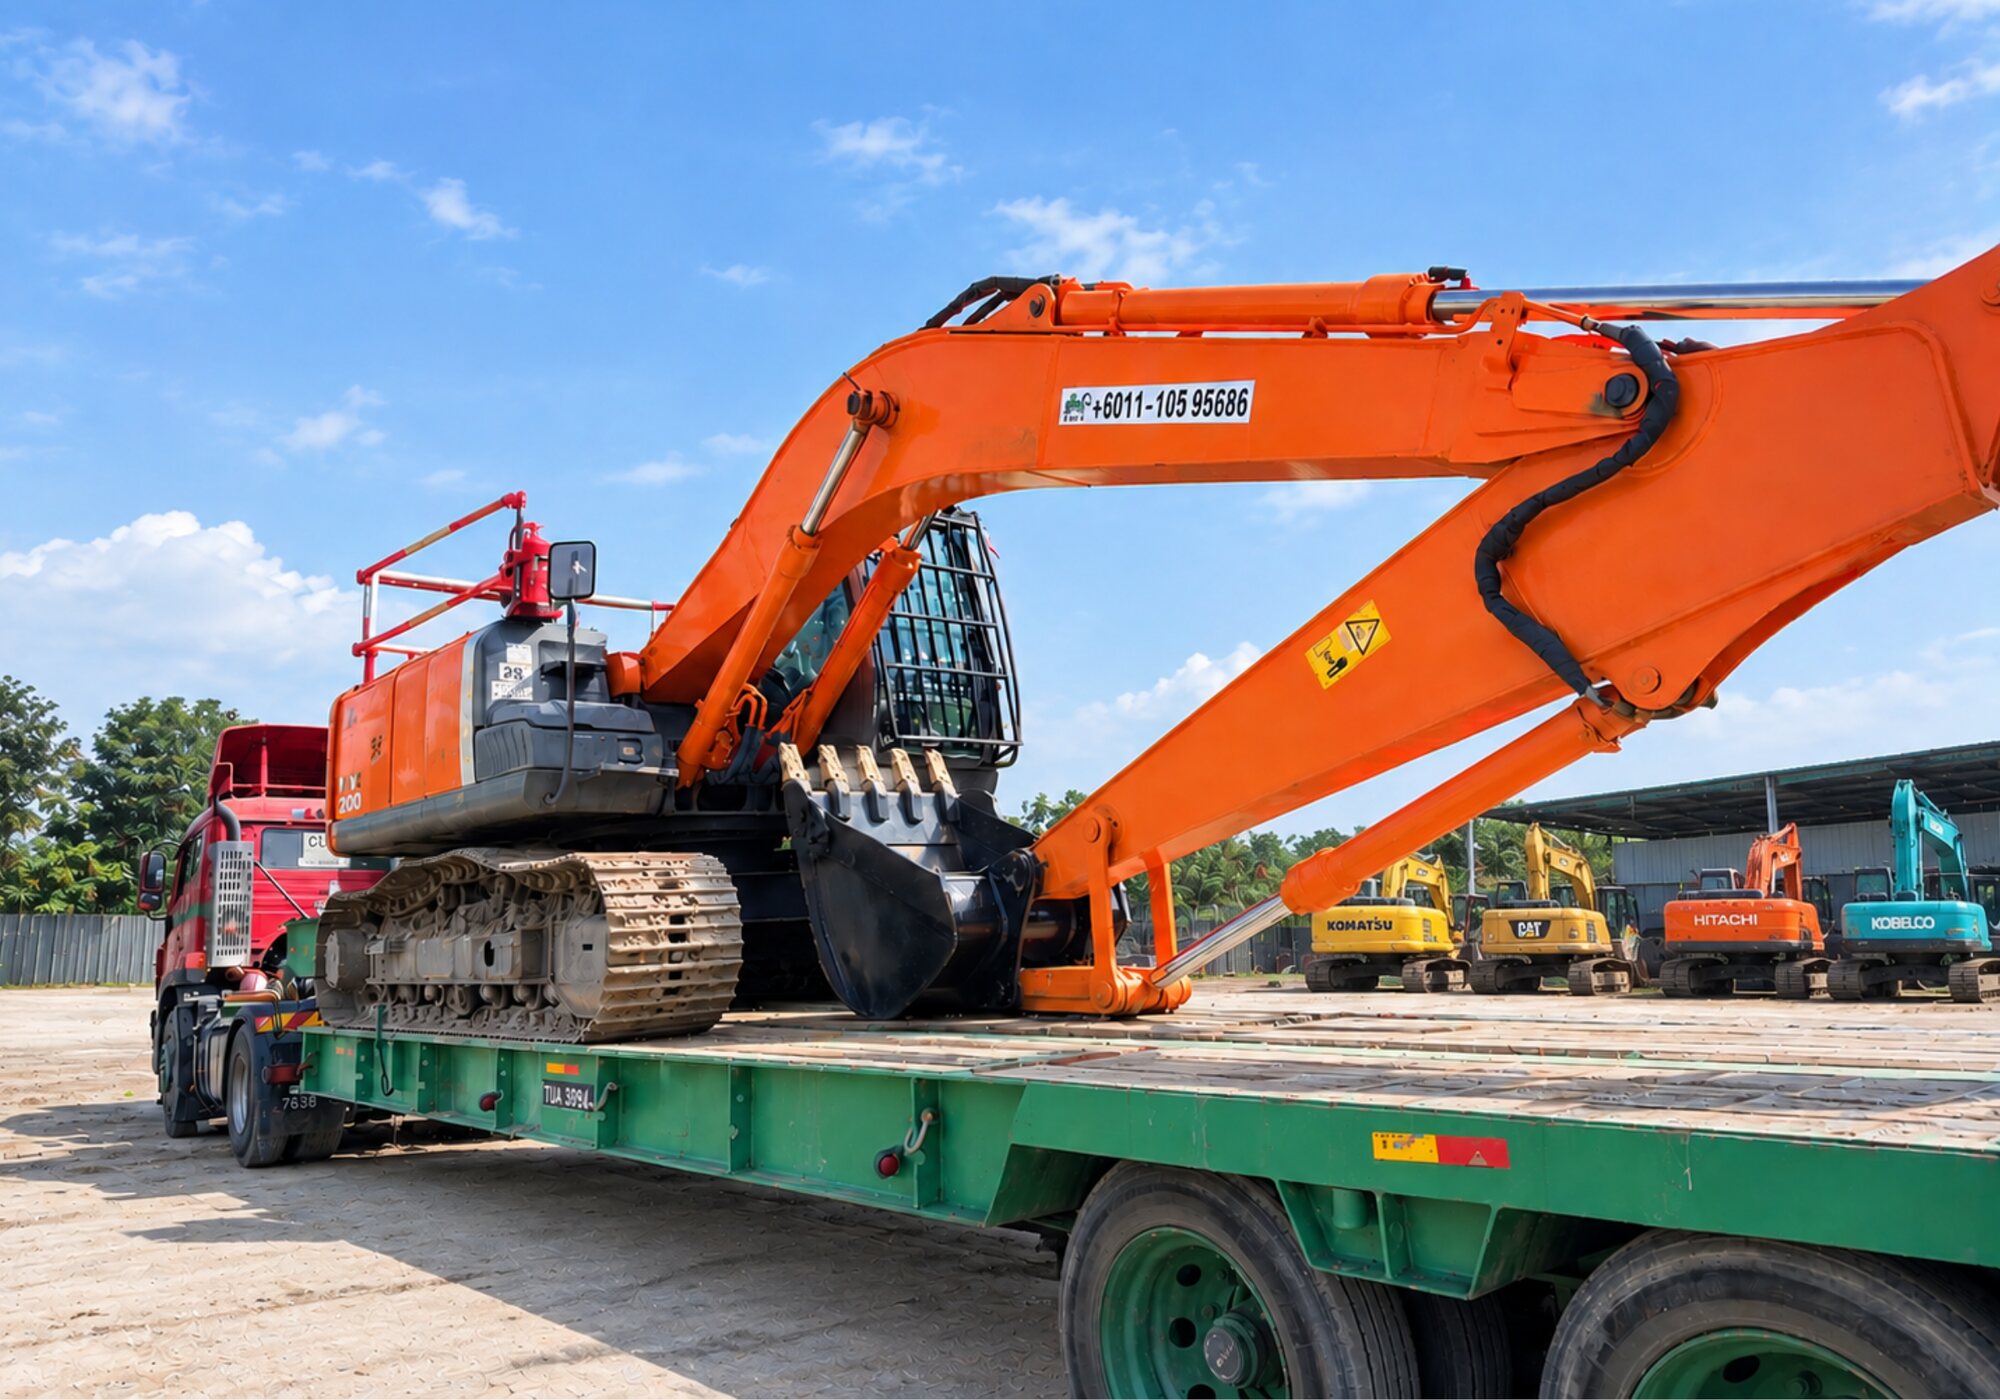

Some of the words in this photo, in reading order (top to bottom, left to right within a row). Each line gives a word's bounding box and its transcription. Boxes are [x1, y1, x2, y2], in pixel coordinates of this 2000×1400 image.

[1093, 389, 1188, 419] +6011-105
[1191, 387, 1249, 418] 95686
[339, 792, 362, 814] 200
[1327, 919, 1393, 931] KOMATSU
[1693, 914, 1758, 926] HITACHI
[1871, 916, 1935, 930] KOBELCO
[1518, 921, 1542, 938] CAT
[282, 1095, 317, 1110] 7638
